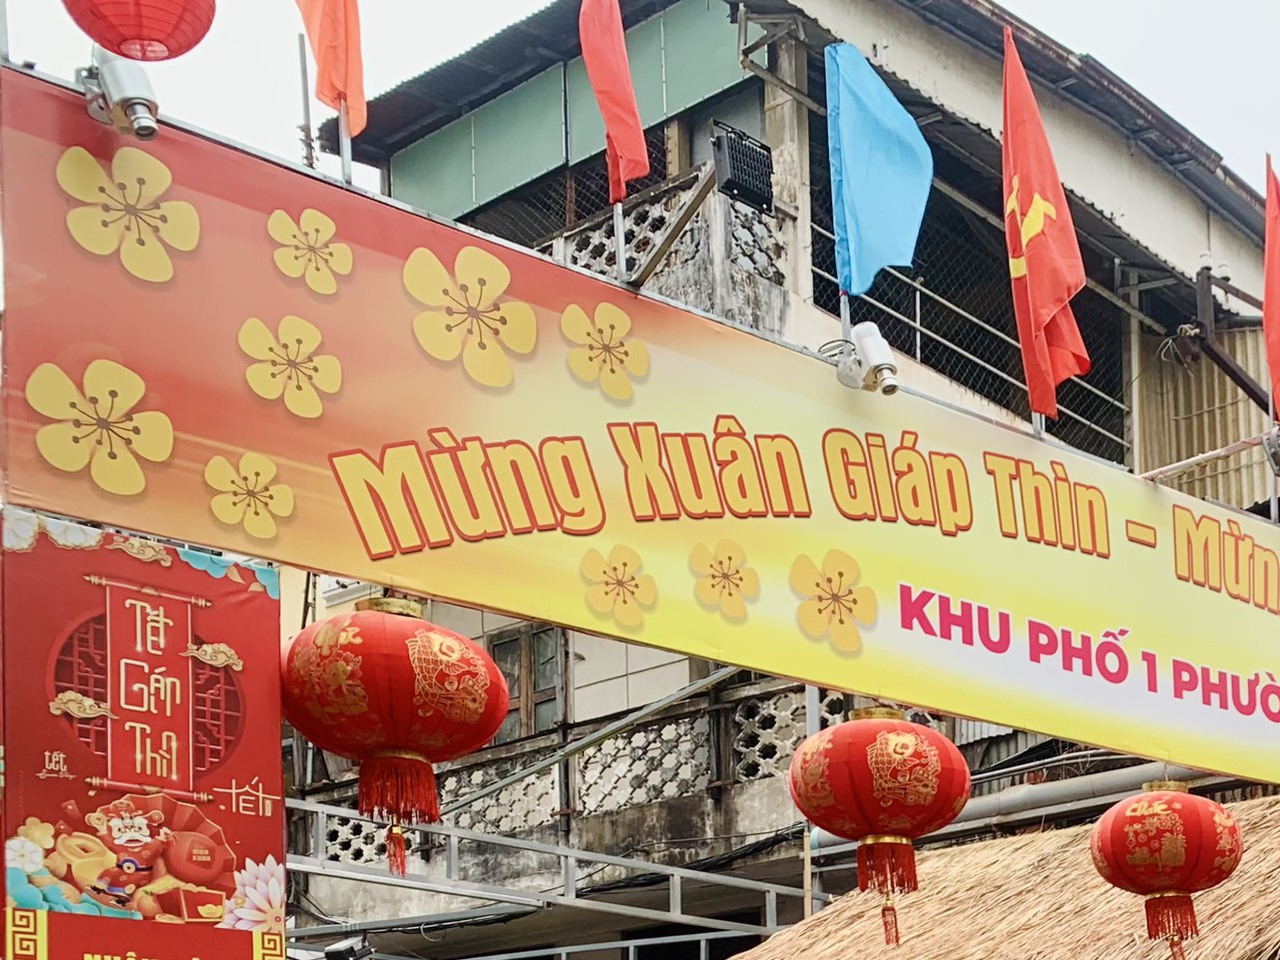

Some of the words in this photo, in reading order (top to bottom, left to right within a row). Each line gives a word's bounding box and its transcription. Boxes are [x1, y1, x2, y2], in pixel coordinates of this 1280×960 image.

[328, 427, 606, 560] Mừng
[607, 415, 812, 521] Xuân
[822, 428, 973, 537] Giáp
[984, 451, 1111, 559] Thìn
[899, 584, 1011, 654] KHU
[1028, 629, 1129, 684] PHỐ
[1141, 651, 1158, 693] 1
